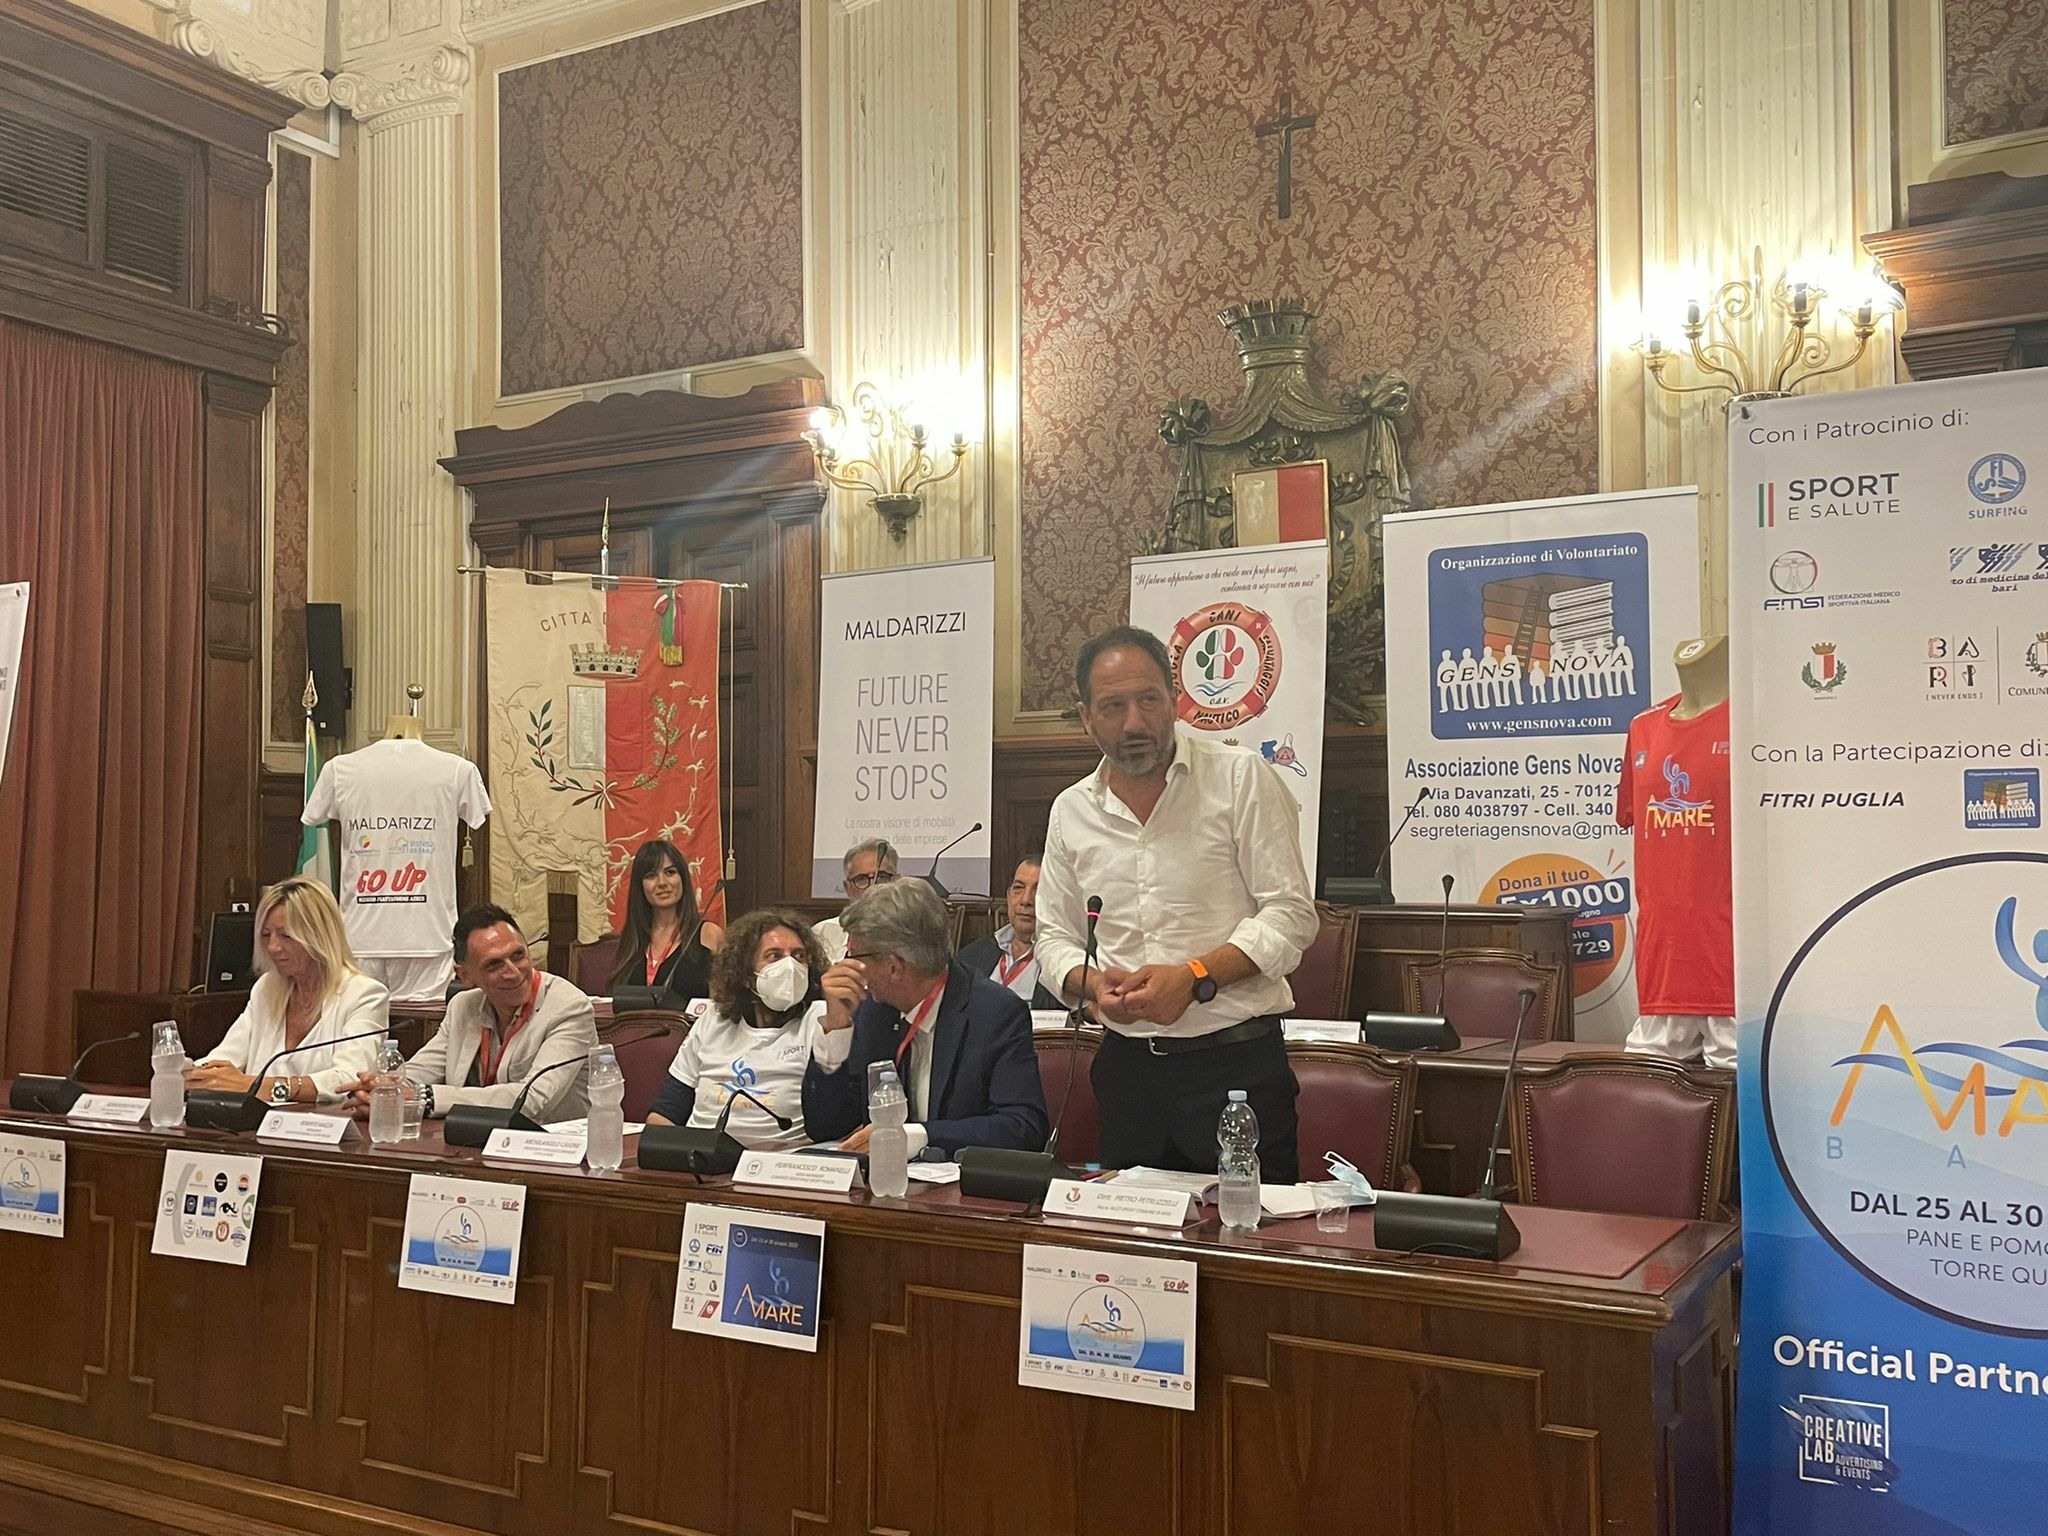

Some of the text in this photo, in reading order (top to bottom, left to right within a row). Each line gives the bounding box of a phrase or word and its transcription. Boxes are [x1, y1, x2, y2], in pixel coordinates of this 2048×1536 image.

[1749, 408, 1969, 445] Con i Patrocinio di:
[1788, 473, 1900, 501] SPORT
[1788, 499, 1900, 520] E SALUTE
[1968, 505, 2028, 520] SURFING
[1441, 544, 1638, 571] Organizzazione di Volontariato
[1965, 576, 1978, 585] di
[1979, 573, 2030, 584] medicina
[1991, 583, 2018, 593] bari
[1827, 591, 1901, 601] FEDERAZIONE MEDICO
[844, 612, 966, 641] MALDARIZZI
[1209, 609, 1241, 623] CANI
[1440, 652, 1628, 684] GENS NOVA
[857, 673, 949, 707] FUTURE
[1194, 709, 1240, 724] NAUTICO
[1466, 714, 1612, 733] www.gensnova.com
[856, 715, 949, 755] NEVER
[1751, 744, 1798, 763] Con
[1805, 745, 1824, 762] la
[1832, 739, 2012, 764] Partecipazione
[1405, 753, 1623, 779] Associazione Gens Nova
[855, 764, 948, 801] STOPS
[1427, 787, 1450, 800] Via
[1454, 785, 1536, 802] Davanzati,
[1540, 785, 1559, 798] 25
[1434, 806, 1460, 819] 080
[1464, 804, 1528, 818] 4038797
[1544, 803, 1581, 817] Cell.
[1585, 802, 1613, 817] 340
[1645, 794, 1714, 829] AMARE
[1759, 791, 1905, 808] FITRI PUGLIA
[349, 817, 436, 831] MALDARIZZI
[845, 818, 855, 829] La
[857, 819, 880, 829] nostra
[883, 818, 911, 829] visione
[923, 816, 955, 827] mobilità
[914, 835, 947, 846] imprese
[357, 861, 427, 893] GO UP
[1499, 869, 1589, 891] Dona il tuo
[1851, 1191, 2043, 1228] DAL 25 AL 30
[1907, 1229, 2048, 1257] PANE E POM
[1930, 1259, 2047, 1286] TORRE QU
[734, 1283, 804, 1326] AMARE
[1773, 1335, 1916, 1381] Official
[1804, 1415, 1882, 1448] CREATIVE
[1805, 1439, 1834, 1463] LAB
[1835, 1455, 1883, 1471] ADVERTISING
[1842, 1467, 1871, 1480] EVENTS
